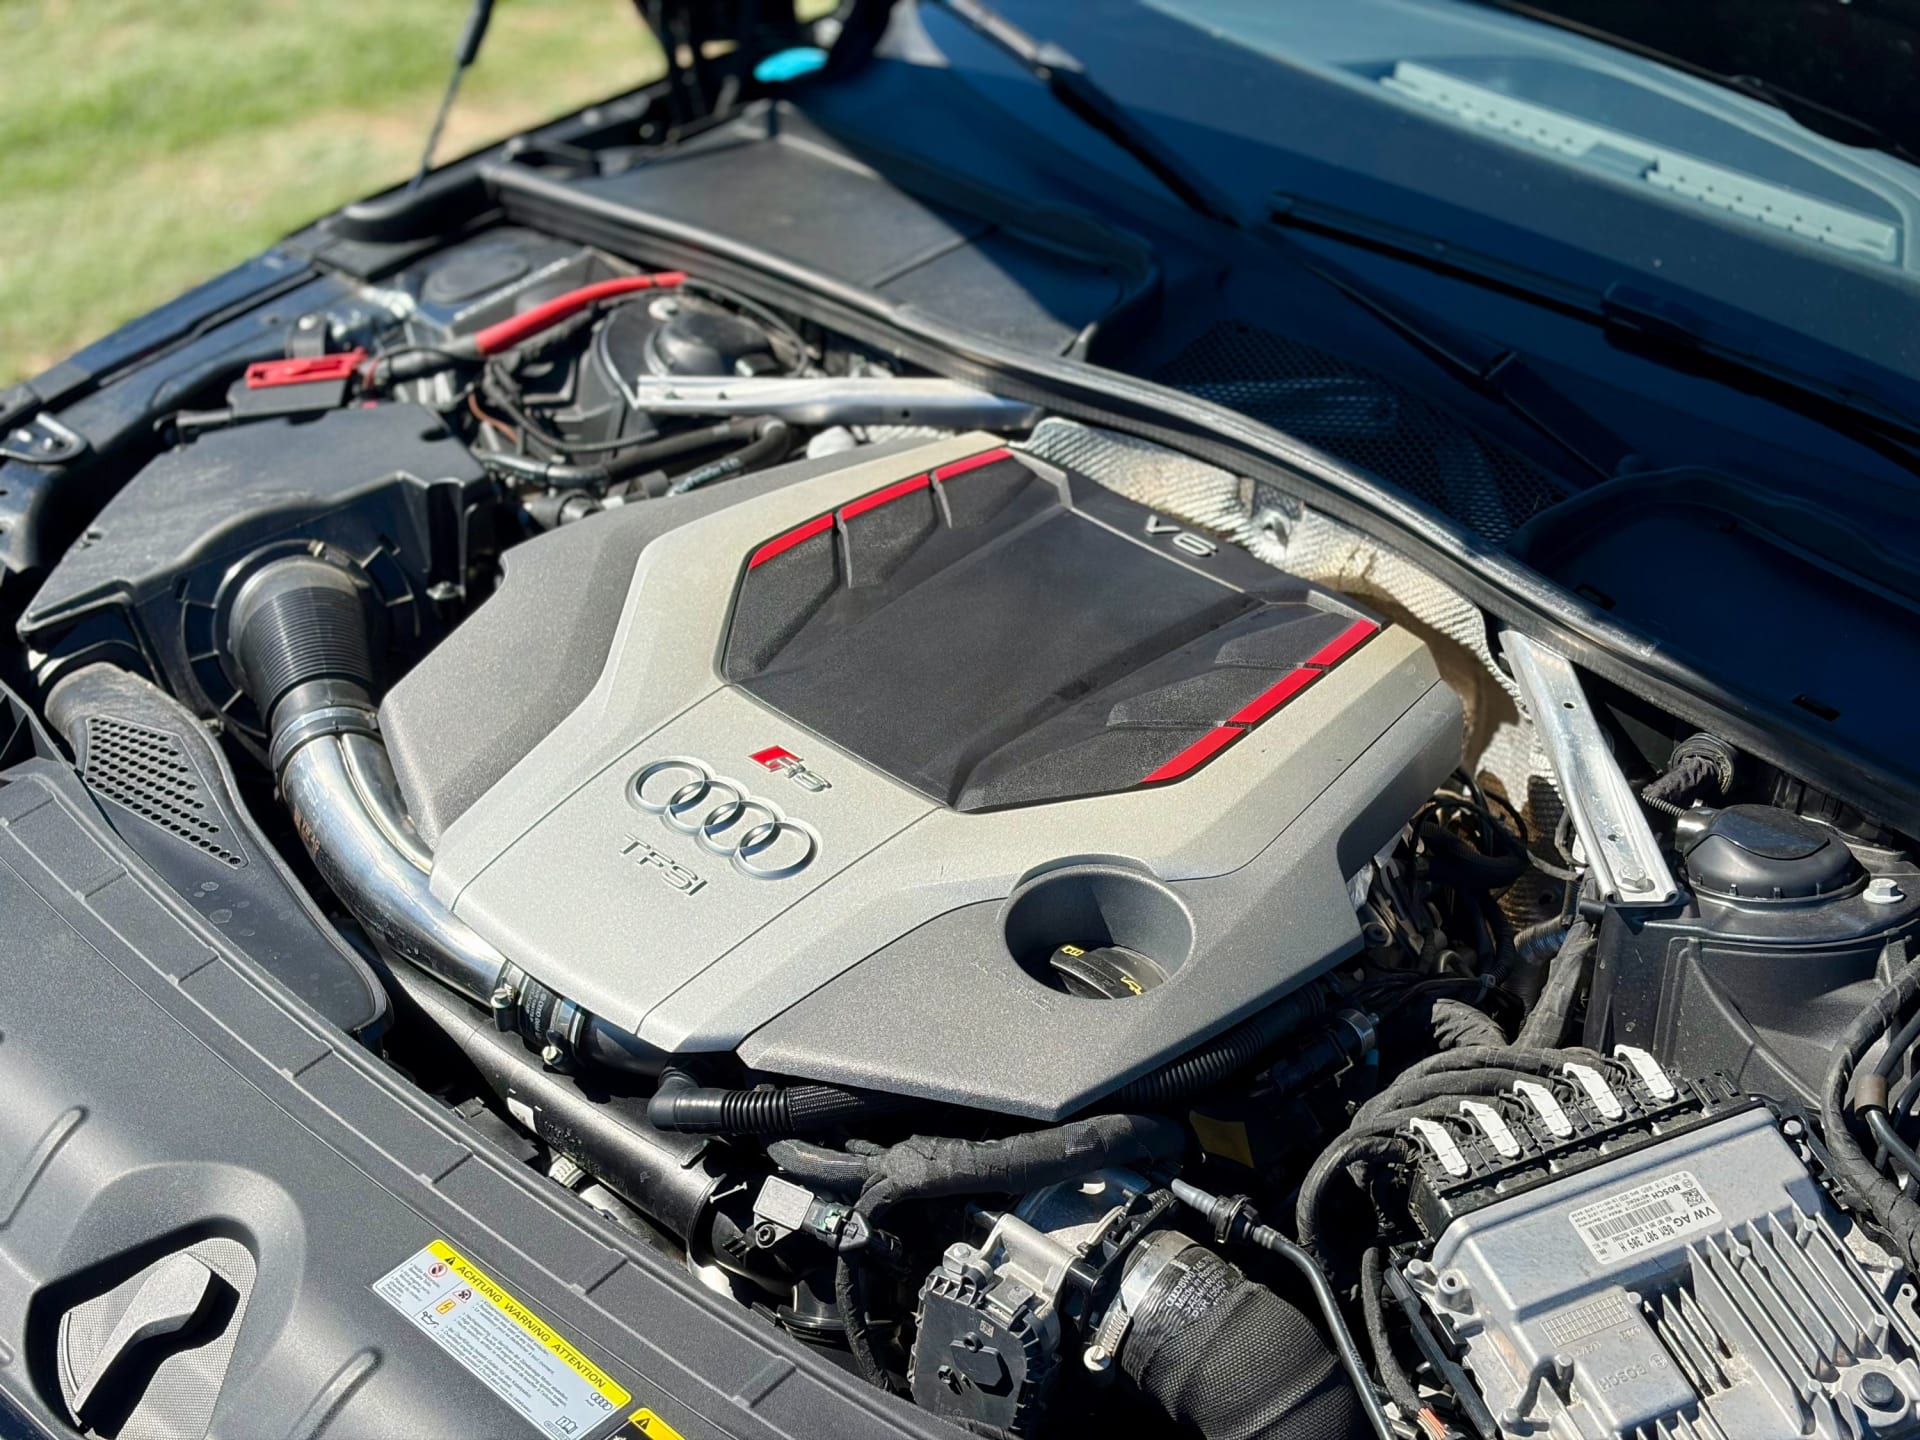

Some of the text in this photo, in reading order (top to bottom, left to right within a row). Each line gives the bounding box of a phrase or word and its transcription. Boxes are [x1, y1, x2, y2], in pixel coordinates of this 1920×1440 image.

[1145, 514, 1218, 556] V6
[618, 832, 709, 897] TFSI
[1651, 1184, 1681, 1199] BOSCH
[1673, 1214, 1691, 1228] AG
[1695, 1206, 1716, 1221] VW
[1627, 1235, 1644, 1249] 309
[1644, 1230, 1660, 1244] 907
[1174, 1285, 1195, 1309] Made
[456, 1264, 504, 1304] ACHTUNG
[503, 1302, 552, 1344] WARNING
[551, 1342, 607, 1389] ATTENTION
[1599, 1364, 1647, 1391] BOSCH
